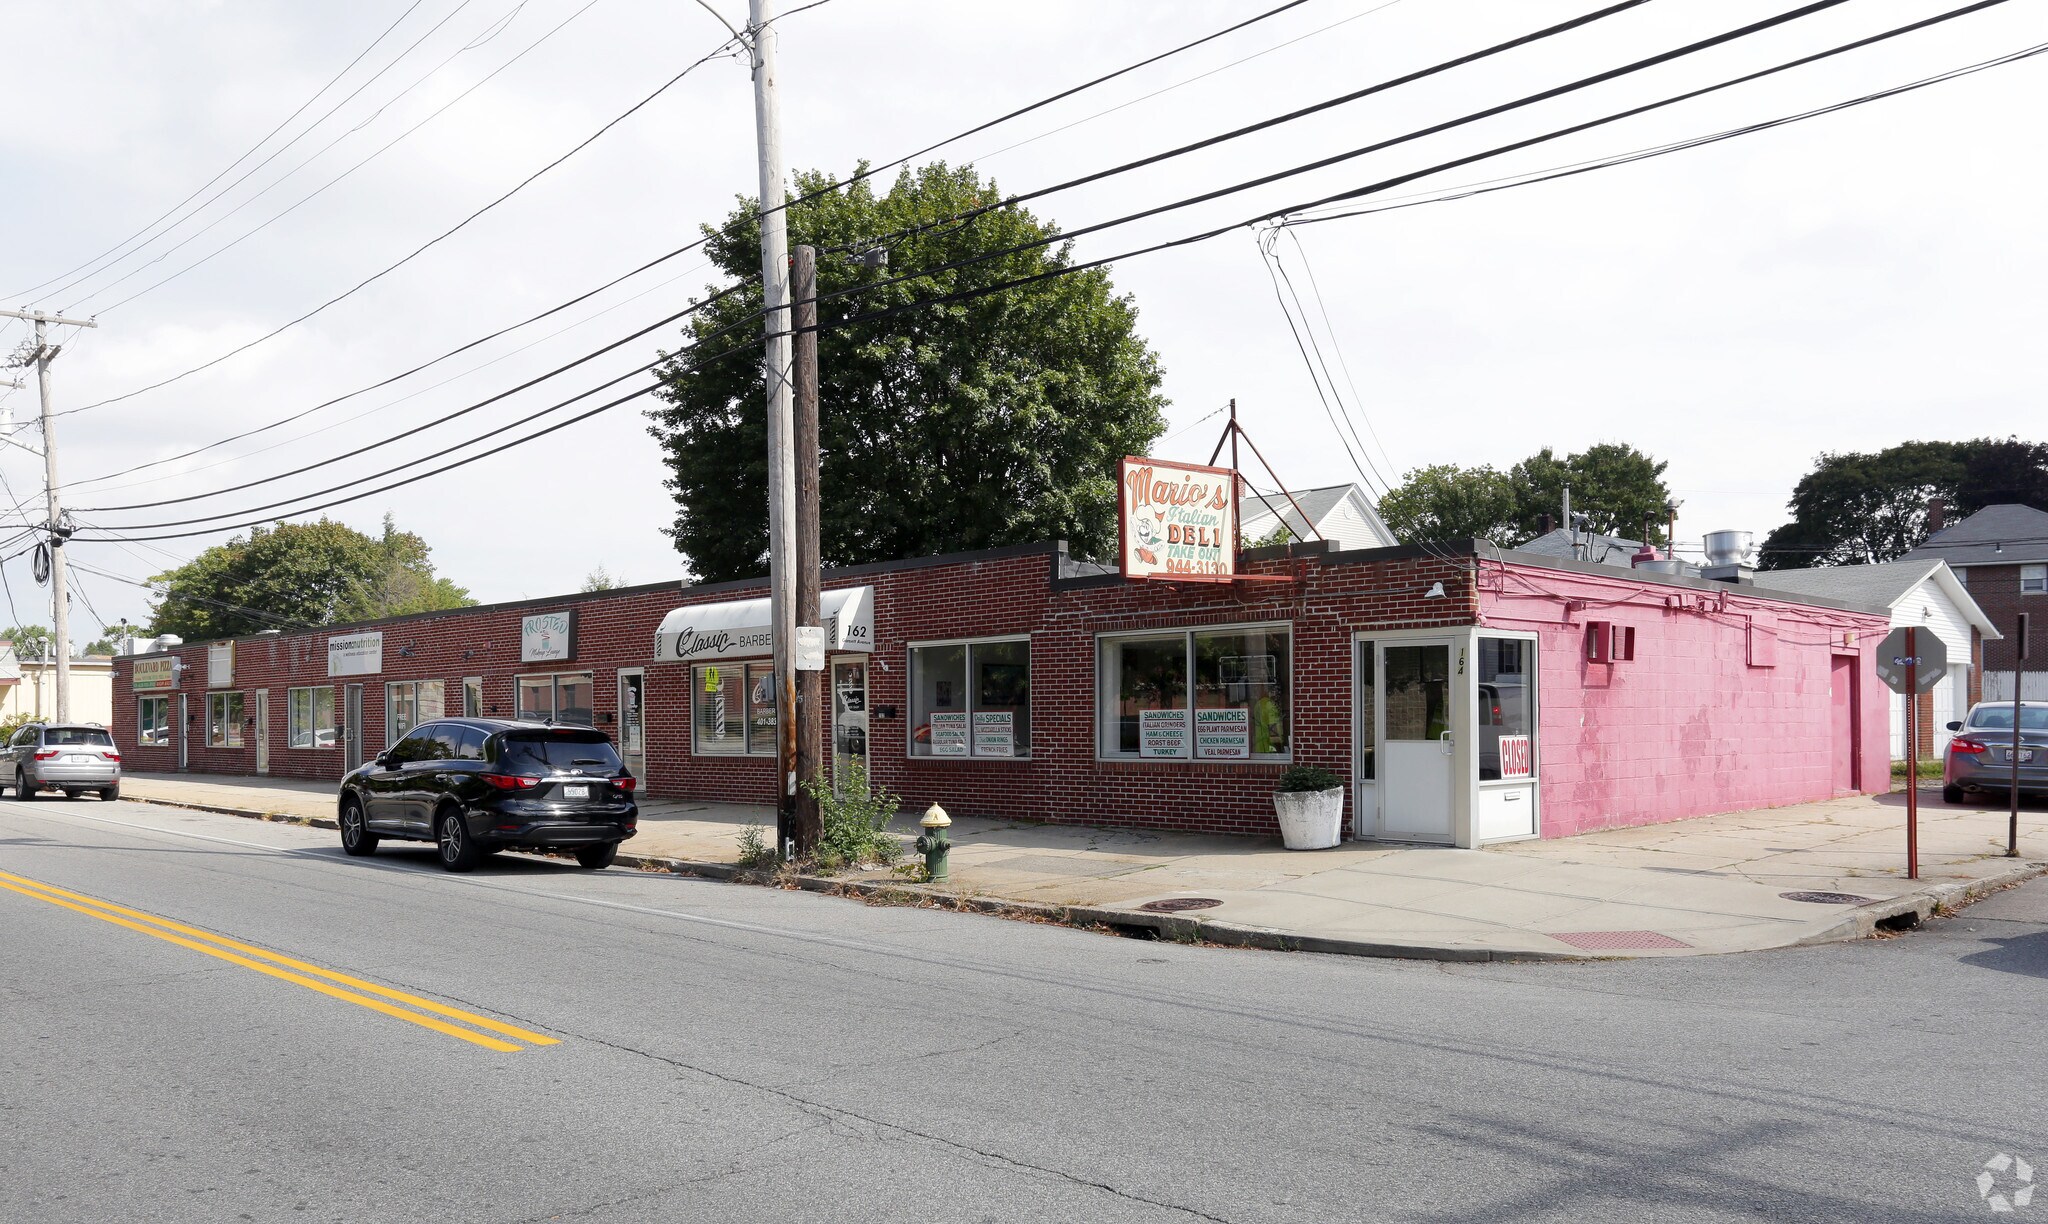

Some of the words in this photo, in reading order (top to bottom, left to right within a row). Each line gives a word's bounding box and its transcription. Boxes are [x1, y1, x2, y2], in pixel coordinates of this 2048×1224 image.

[1126, 467, 1229, 515] Mario's
[1167, 506, 1220, 527] Italian
[1167, 524, 1221, 548] DELI
[1168, 545, 1196, 559] TAKE
[1198, 548, 1222, 561] OUT
[524, 616, 568, 636] FROSTED
[848, 625, 868, 639] 162
[675, 626, 737, 658] Classic
[739, 633, 772, 649] BARBE
[1457, 648, 1465, 676] 164
[756, 707, 776, 715] BARBER
[985, 714, 1011, 722] SPECIALS
[1144, 711, 1185, 719] SANDWICHES
[1197, 711, 1247, 721] SANDWICHES
[757, 717, 777, 726] 401-383
[1199, 737, 1219, 745] CHICKEN
[1220, 737, 1245, 745] PARMESAN
[1204, 748, 1216, 756] VEAL
[1502, 739, 1529, 776] CLOSED
